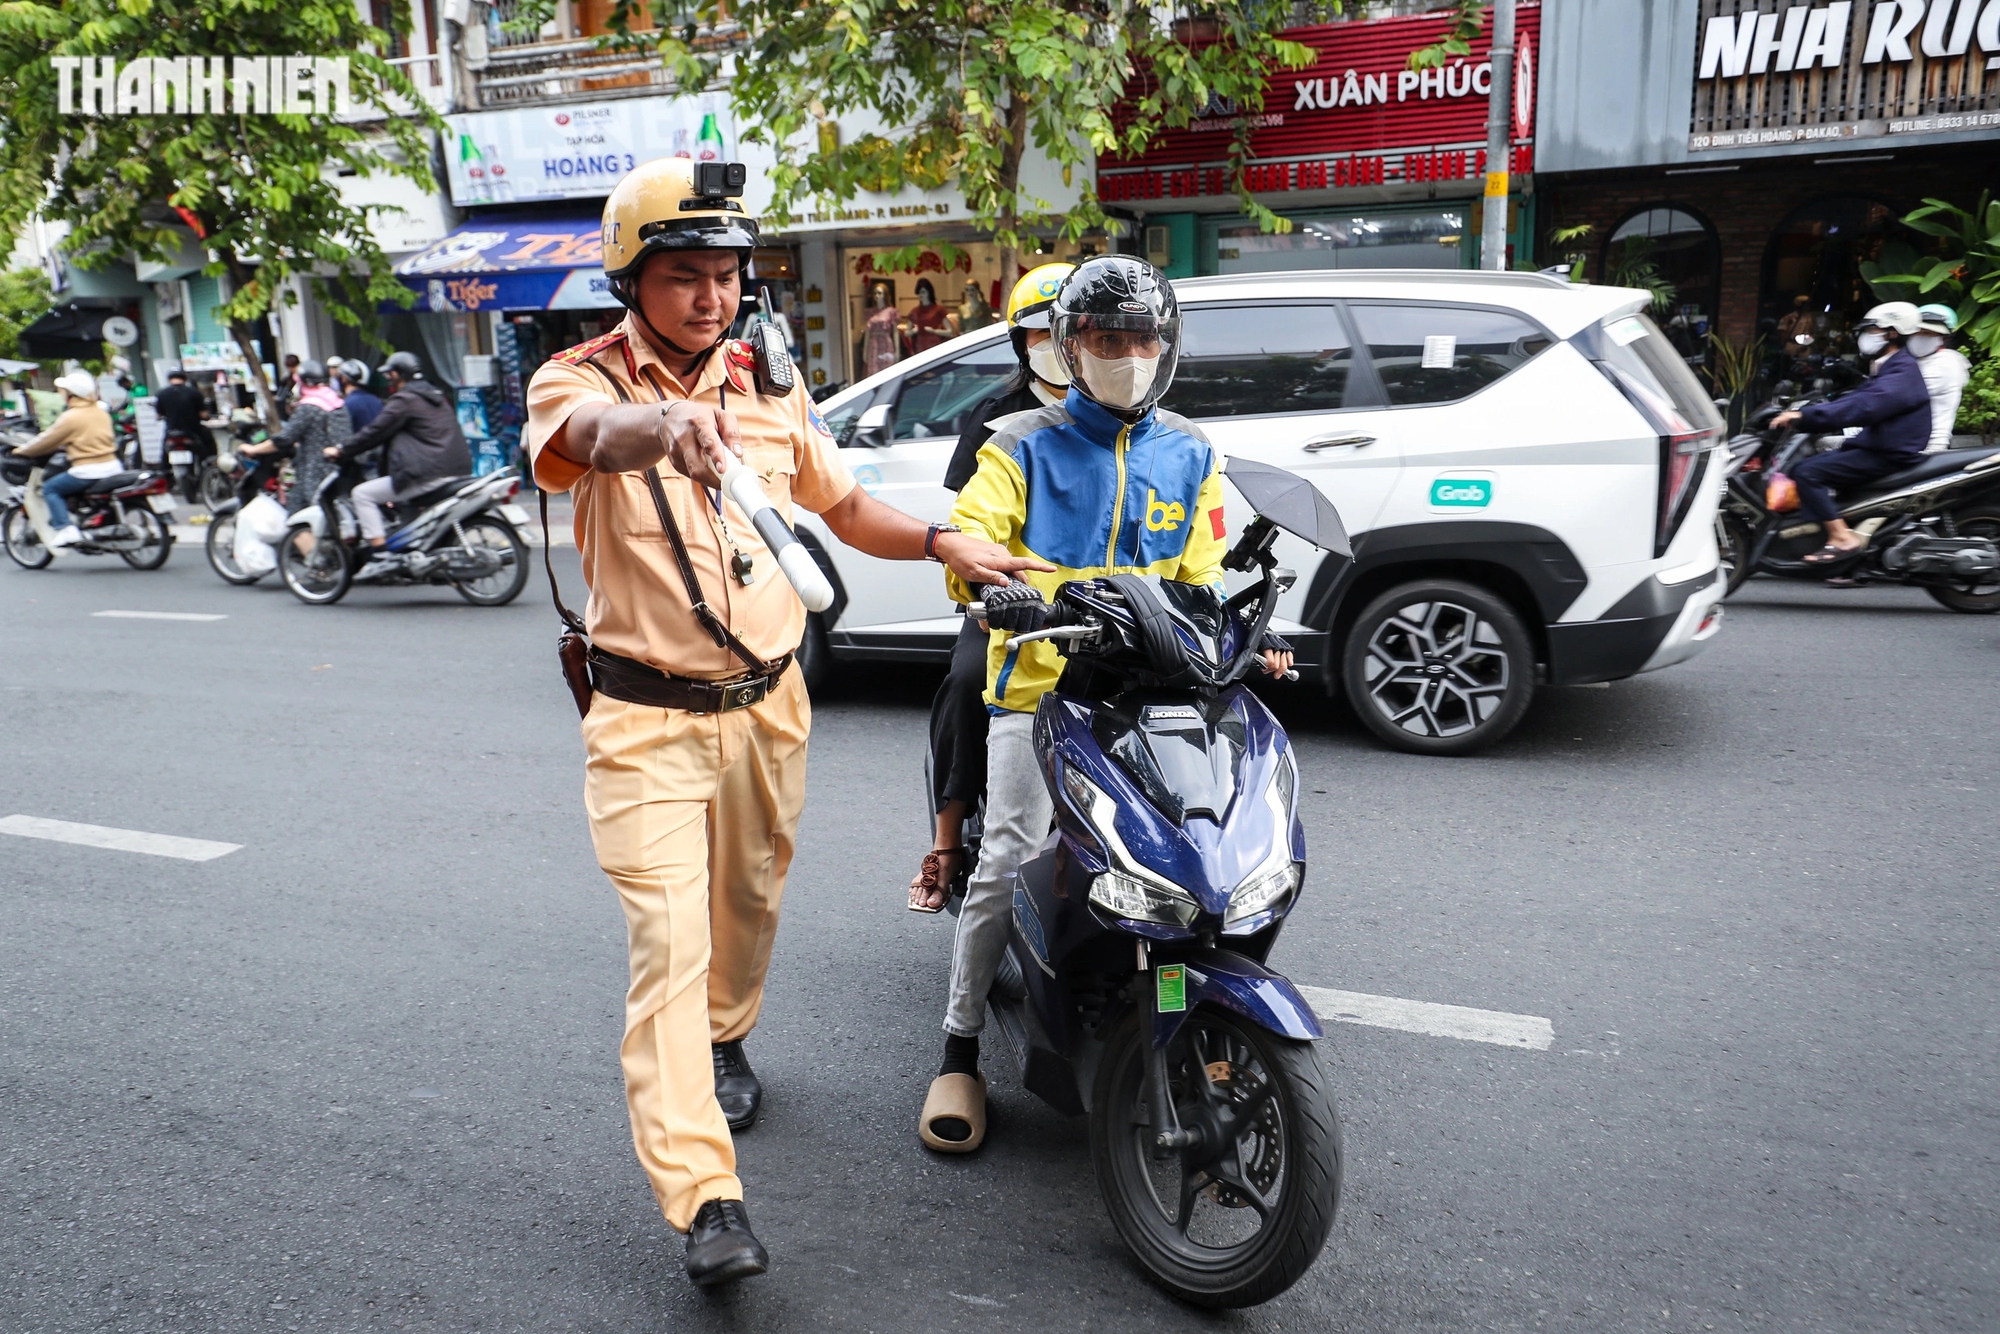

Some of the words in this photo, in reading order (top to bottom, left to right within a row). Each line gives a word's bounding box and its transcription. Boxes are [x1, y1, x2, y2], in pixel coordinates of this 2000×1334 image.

[1294, 69, 1388, 111] XUÂN
[572, 108, 611, 119] PILSNER
[1937, 116, 1962, 130] 0933
[1965, 115, 1978, 127] 14
[1693, 136, 1709, 148] 120
[543, 151, 618, 178] HOÀNG
[625, 154, 636, 173] 3
[1297, 159, 1328, 189] GIA
[1334, 152, 1384, 188] CÔNG
[1404, 145, 1466, 183] THÀNH
[447, 277, 499, 309] Tiger
[1436, 485, 1486, 502] Grab
[1145, 488, 1186, 532] be
[1148, 710, 1198, 719] HONDA
